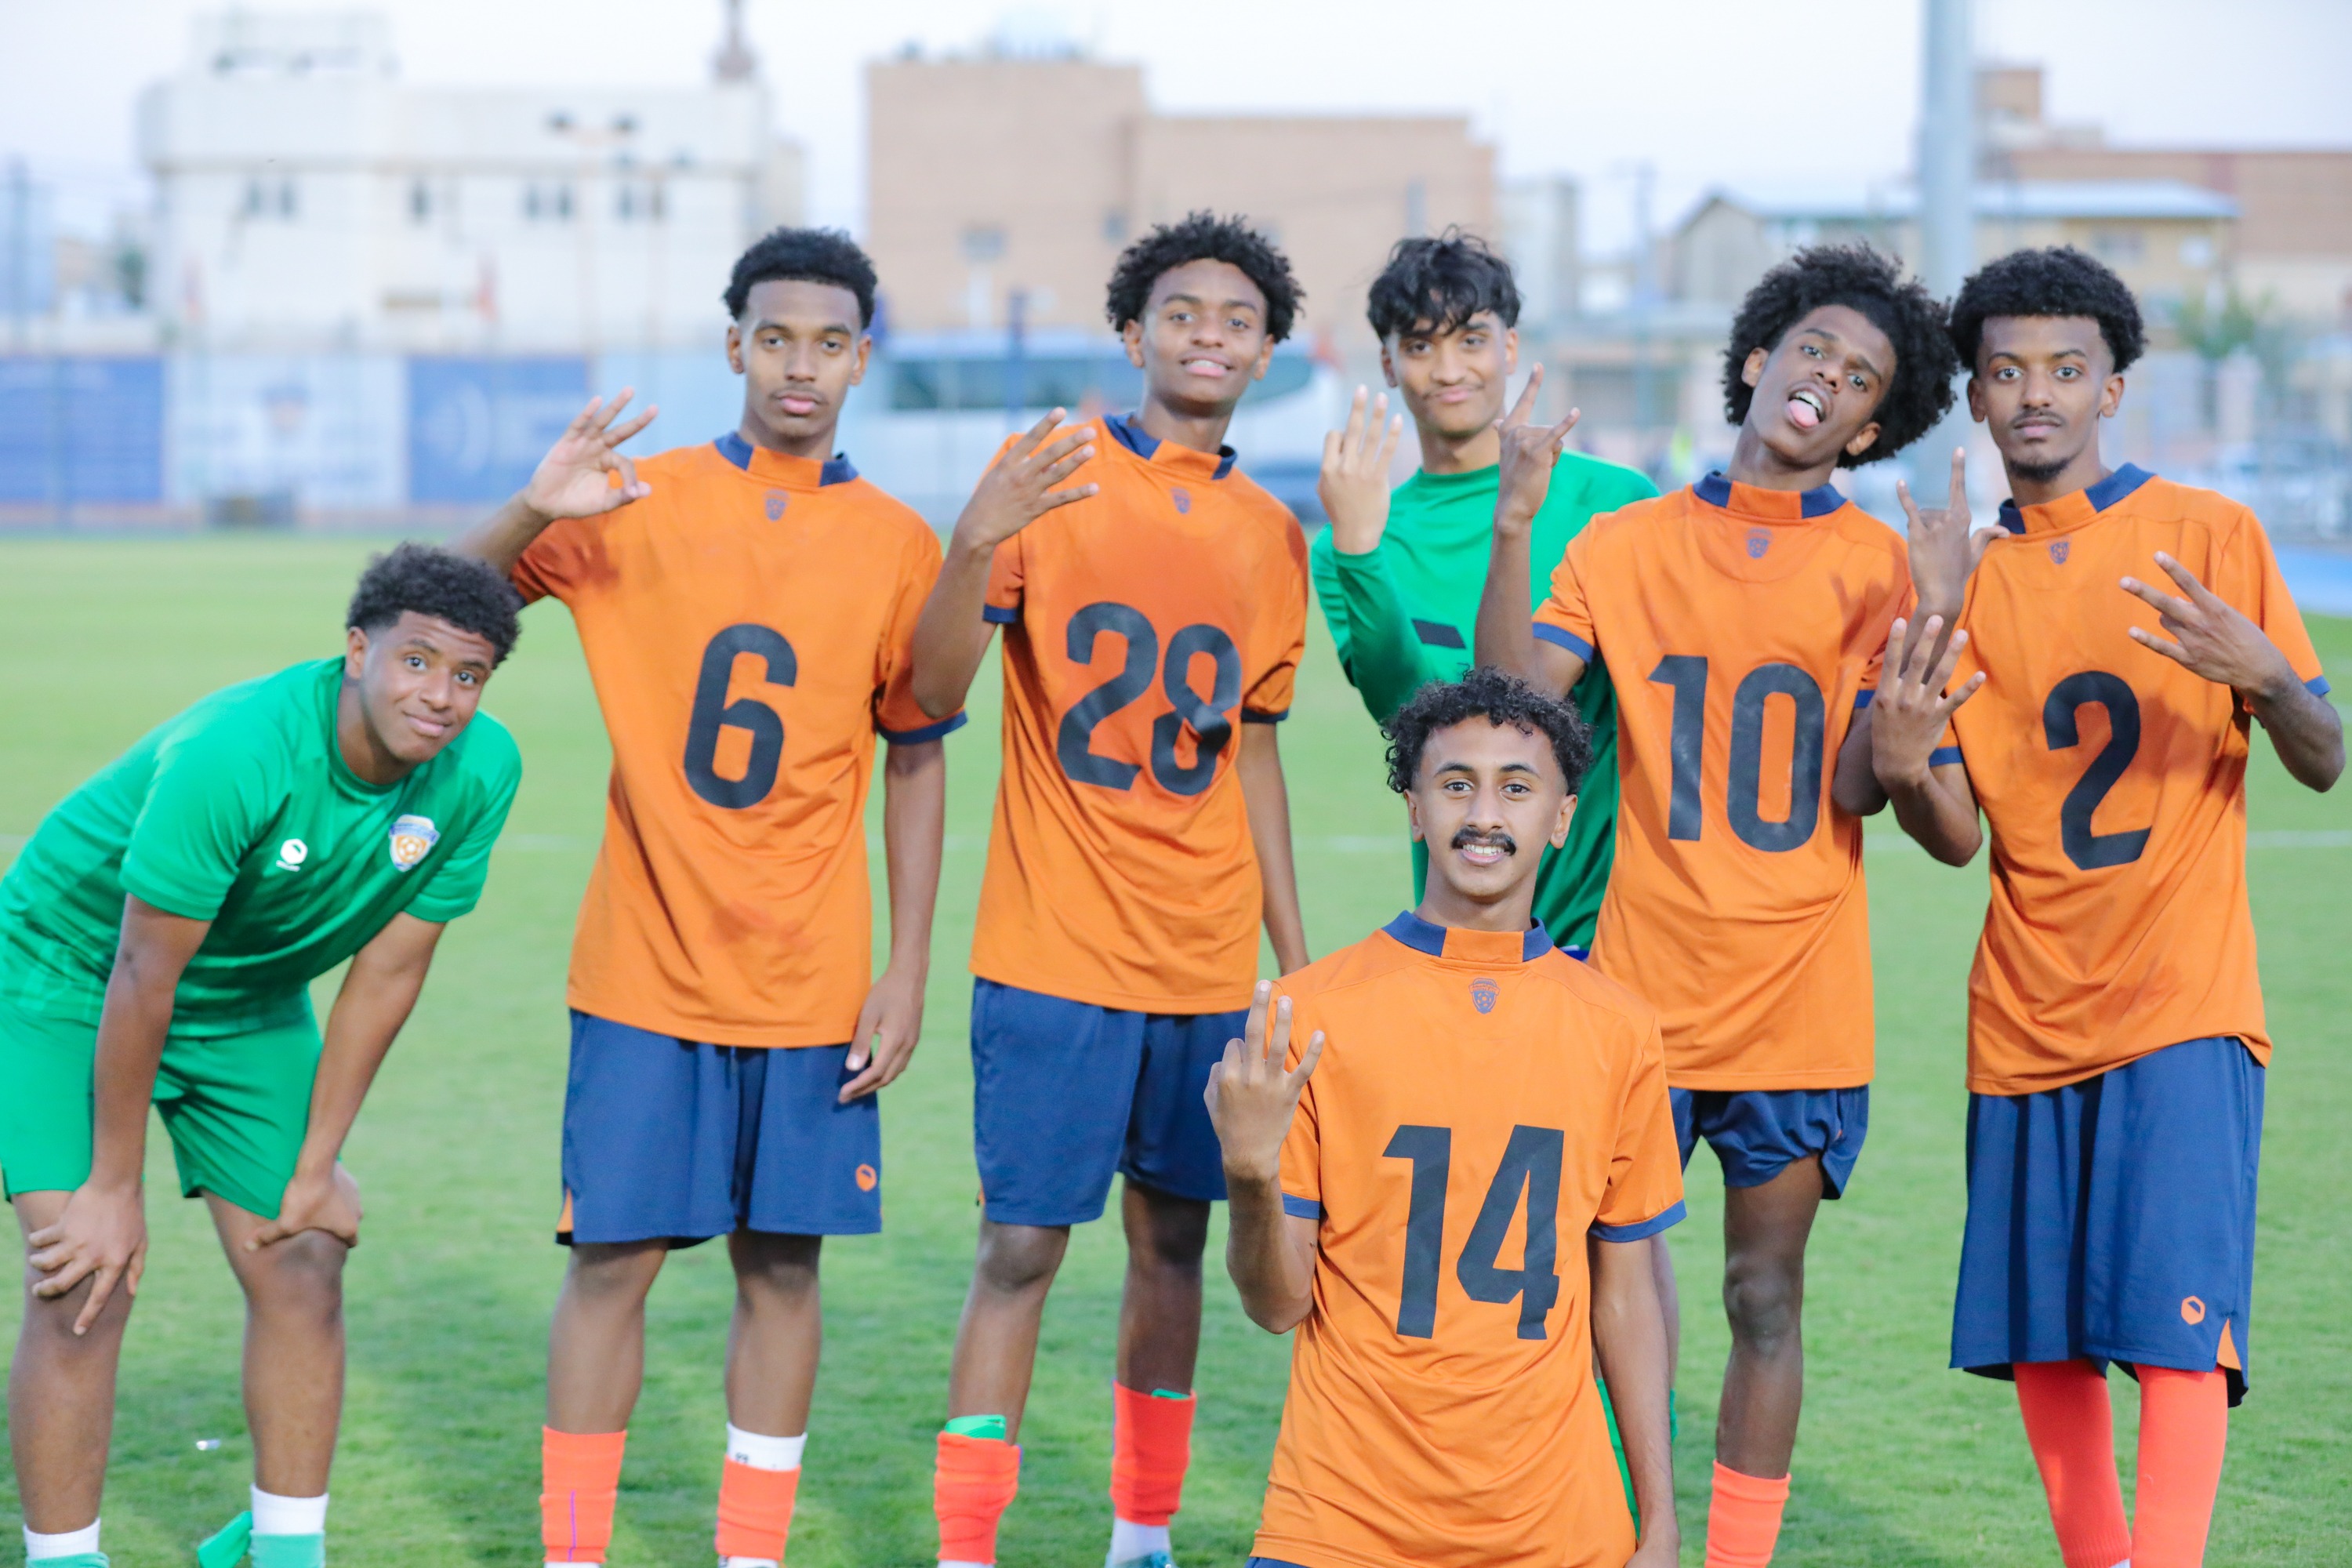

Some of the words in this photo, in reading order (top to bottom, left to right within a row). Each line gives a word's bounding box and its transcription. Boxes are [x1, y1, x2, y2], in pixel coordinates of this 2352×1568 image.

[684, 623, 797, 809] 6
[1057, 601, 1241, 797] 28
[1648, 655, 1825, 852] 10
[2042, 670, 2152, 870] 2
[1382, 1124, 1564, 1340] 14
